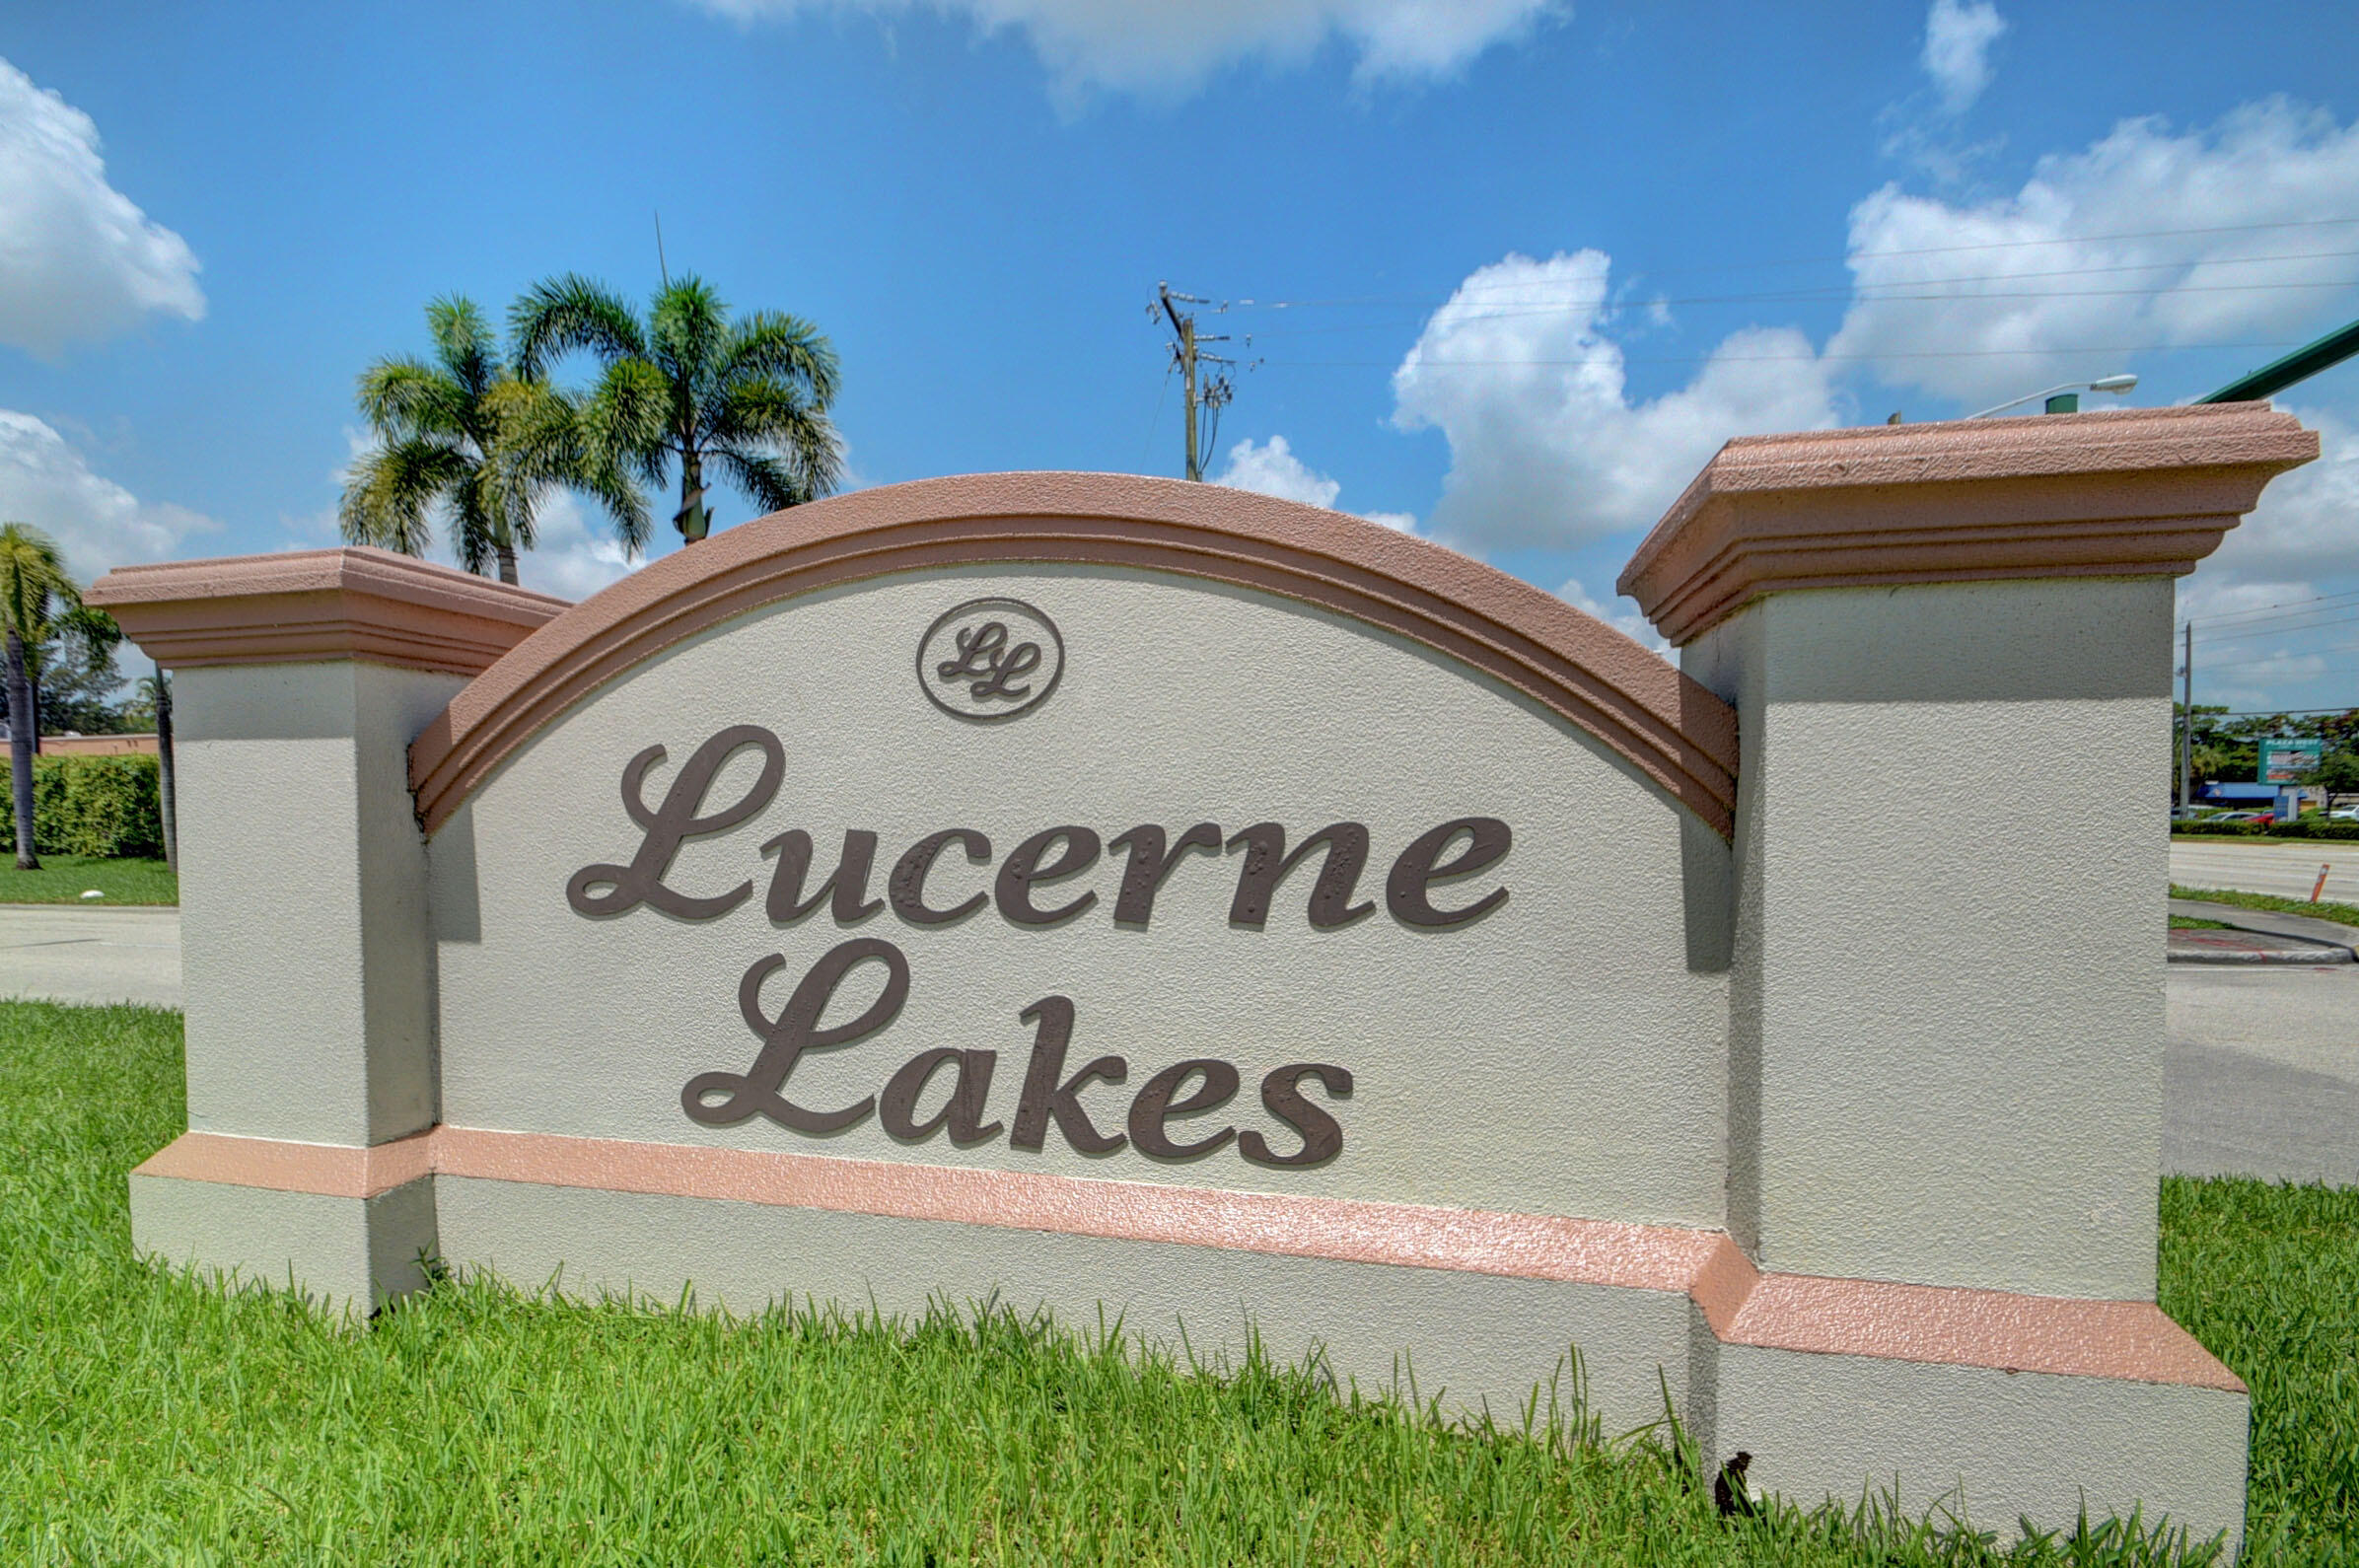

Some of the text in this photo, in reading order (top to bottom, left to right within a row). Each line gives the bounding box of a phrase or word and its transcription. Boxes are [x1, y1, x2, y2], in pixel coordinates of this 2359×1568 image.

[937, 621, 1042, 697] LL
[565, 724, 1513, 935] Lucerne
[680, 937, 1354, 1172] Lakes
